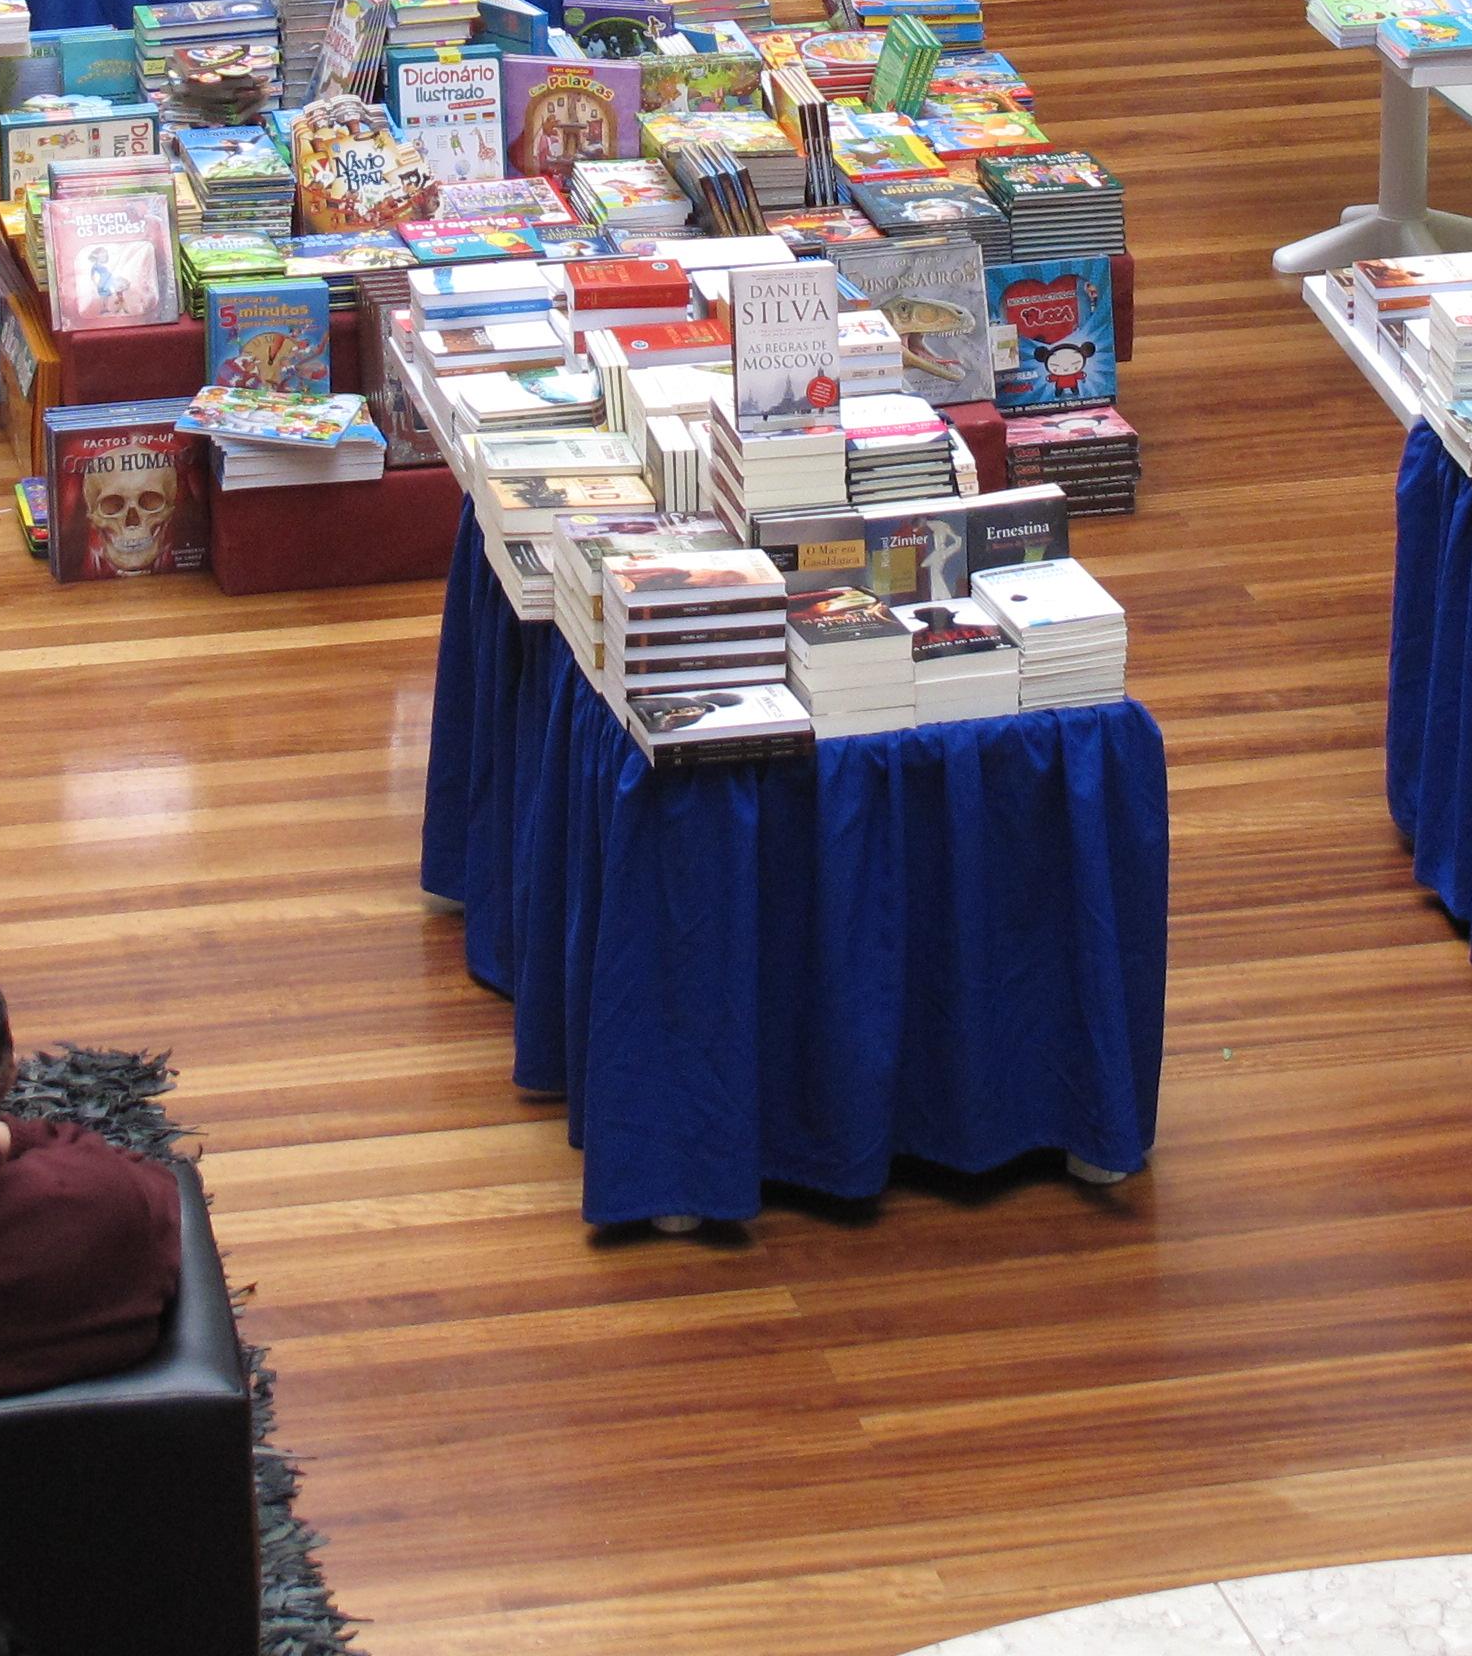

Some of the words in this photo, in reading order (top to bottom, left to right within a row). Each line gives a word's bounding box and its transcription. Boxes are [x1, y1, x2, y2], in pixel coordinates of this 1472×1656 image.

[403, 65, 495, 85] Dicionário
[416, 85, 484, 103] Ilustrado
[548, 75, 614, 100] Palavras
[335, 152, 385, 174] NAVIO
[77, 225, 93, 237] os
[438, 215, 519, 229] rapariga
[848, 259, 980, 295] DINOSSAUROS
[750, 281, 821, 299] DANIEL
[220, 306, 237, 327] 5
[239, 305, 309, 317] minutos
[742, 299, 831, 326] SILVA
[748, 342, 762, 354] AS
[765, 341, 809, 353] REGRAS
[813, 340, 827, 351] DE
[743, 352, 834, 371] MOSCOVO
[83, 438, 127, 449] FACTOS
[132, 433, 174, 444] POP-UP
[986, 522, 1050, 540] Ernestina
[807, 546, 816, 554] O
[820, 545, 839, 554] Mar
[842, 545, 856, 553] em
[890, 534, 928, 547] Zimler
[803, 555, 860, 567] Casablanca
